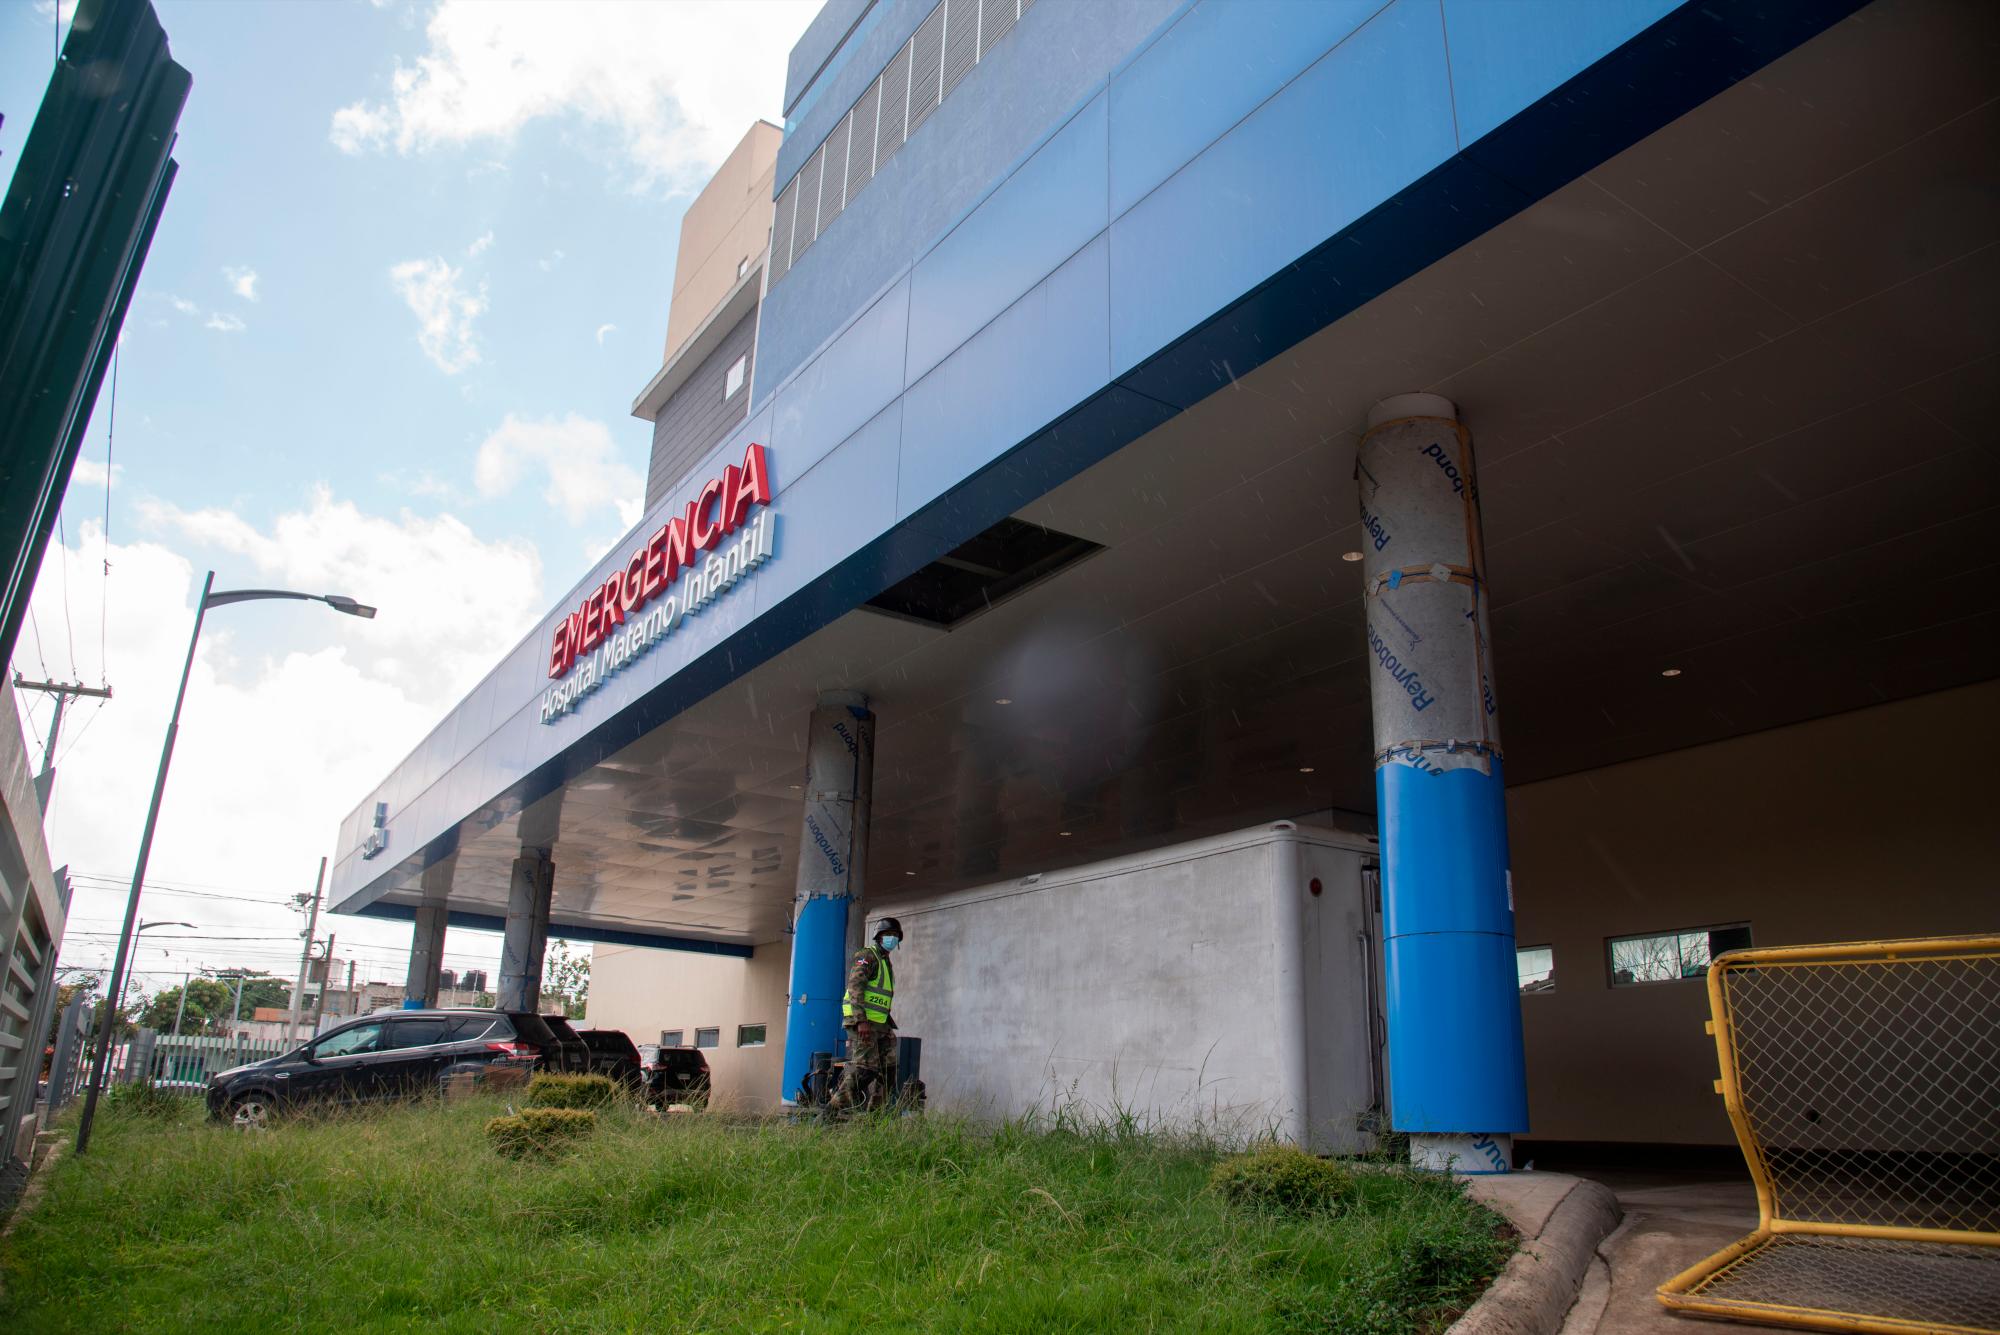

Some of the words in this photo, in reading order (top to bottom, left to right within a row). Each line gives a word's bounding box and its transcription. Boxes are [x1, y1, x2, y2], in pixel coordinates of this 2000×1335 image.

[540, 649, 603, 724] Hospital
[601, 595, 683, 677] Materno
[681, 509, 776, 615] Infantil
[548, 443, 770, 679] EMERGENCIA
